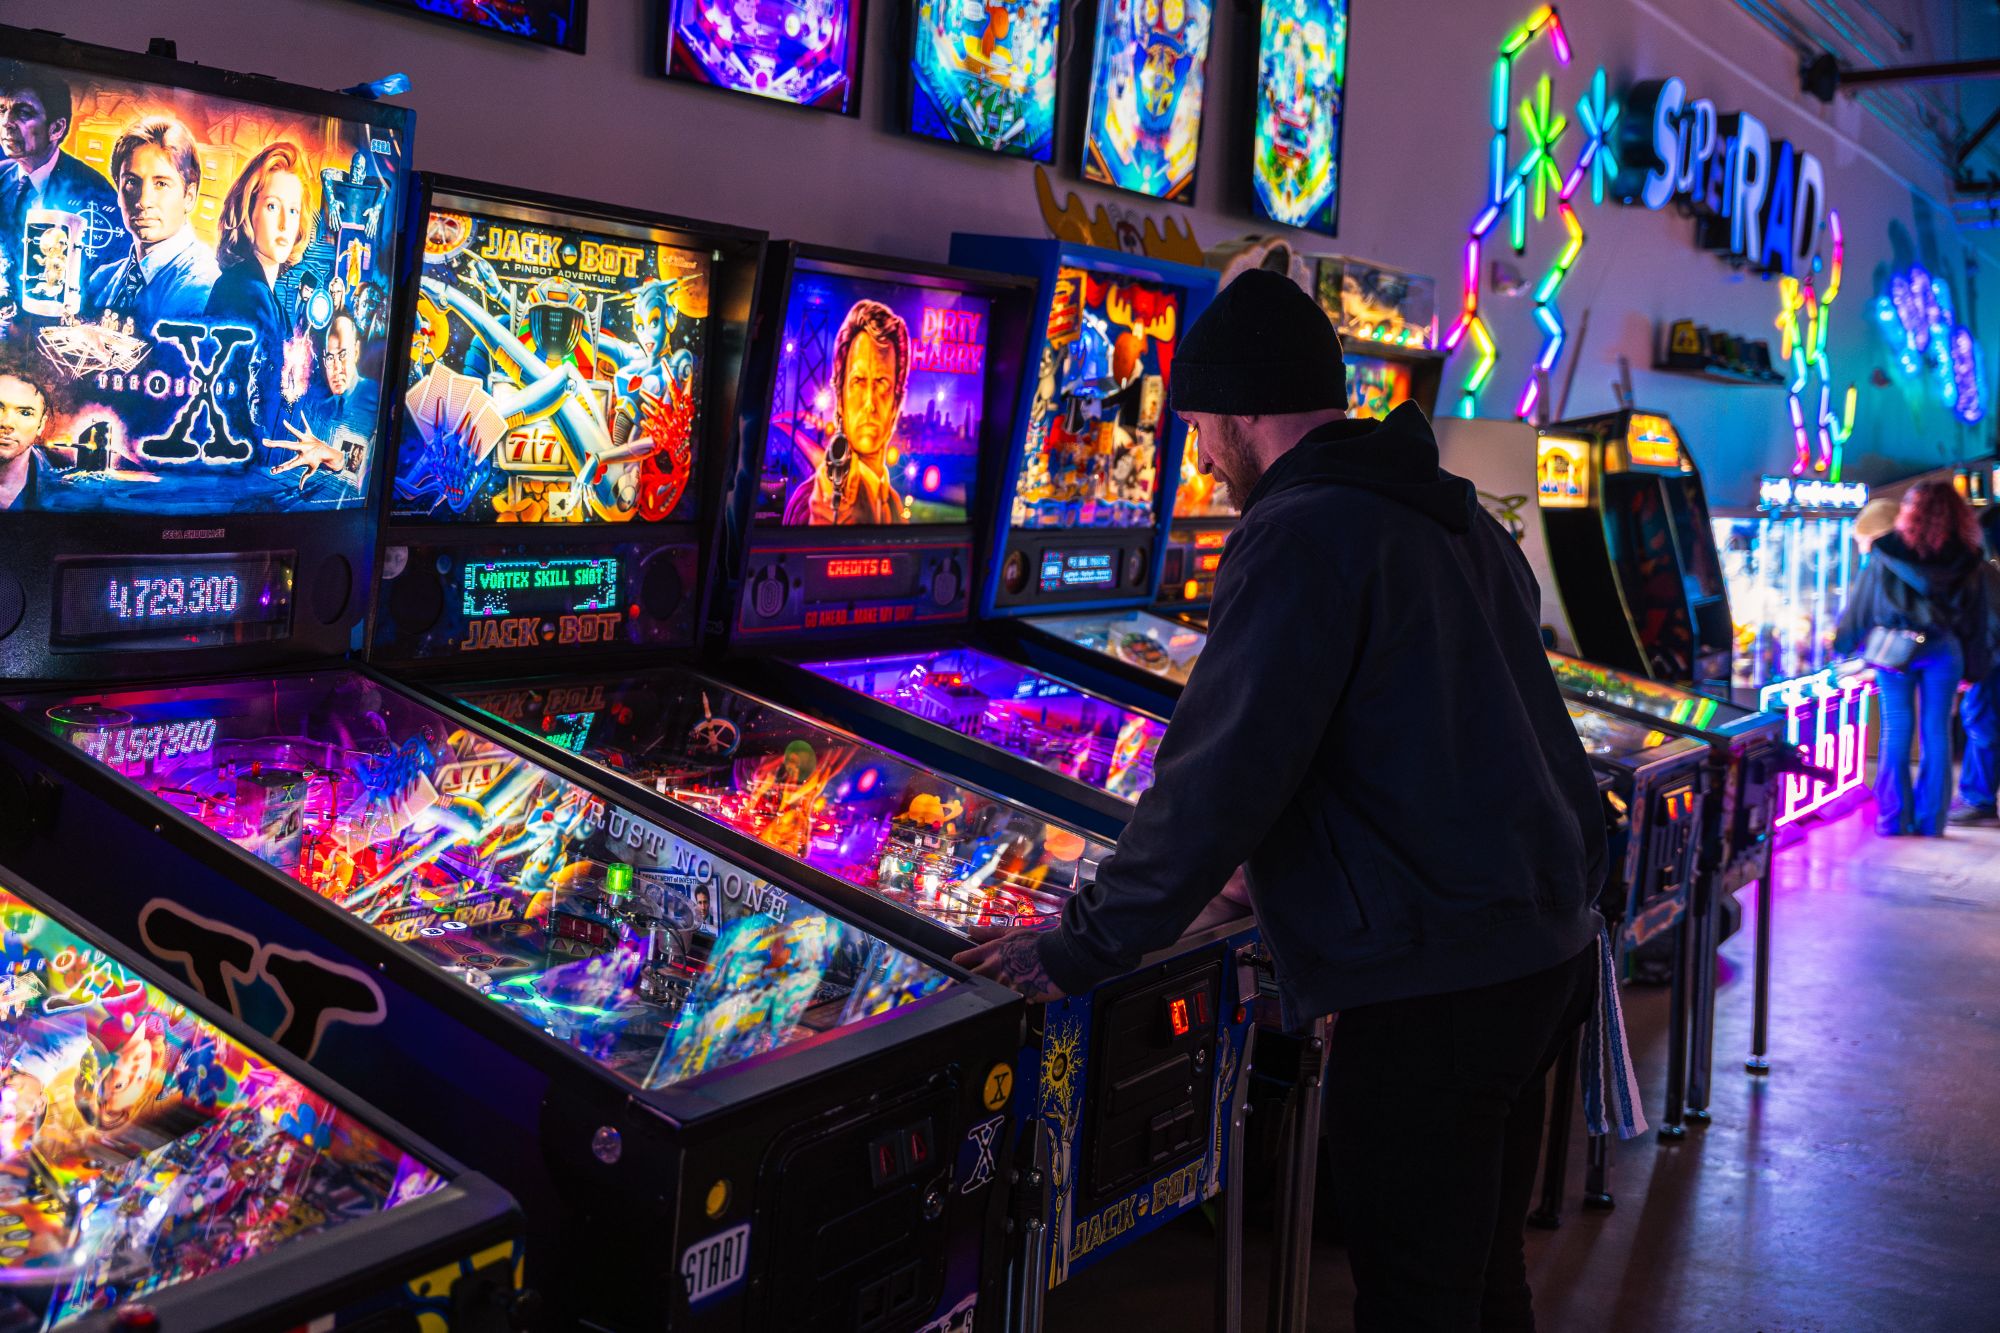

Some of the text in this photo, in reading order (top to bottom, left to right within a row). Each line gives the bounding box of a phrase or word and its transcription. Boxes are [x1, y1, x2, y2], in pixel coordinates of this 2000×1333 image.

[371, 138, 391, 155] SEGA
[1731, 112, 1825, 278] RAD
[481, 227, 644, 278] JACK BOT
[502, 262, 617, 285] A PINBOT ADVENTURE
[922, 307, 982, 344] DIRTY
[911, 338, 984, 374] HARRY
[98, 374, 139, 390] THE
[162, 529, 183, 540] SEGA
[480, 567, 604, 590] VORTEX SKILL SHOT
[828, 560, 879, 577] CREDITS
[109, 575, 237, 618] 4,729,300
[461, 613, 621, 650] JACK BOT
[567, 789, 789, 925] TRUST NO ONE
[989, 1071, 1010, 1105] X
[1070, 1157, 1205, 1262] JACK BOT
[685, 1230, 746, 1297] START
